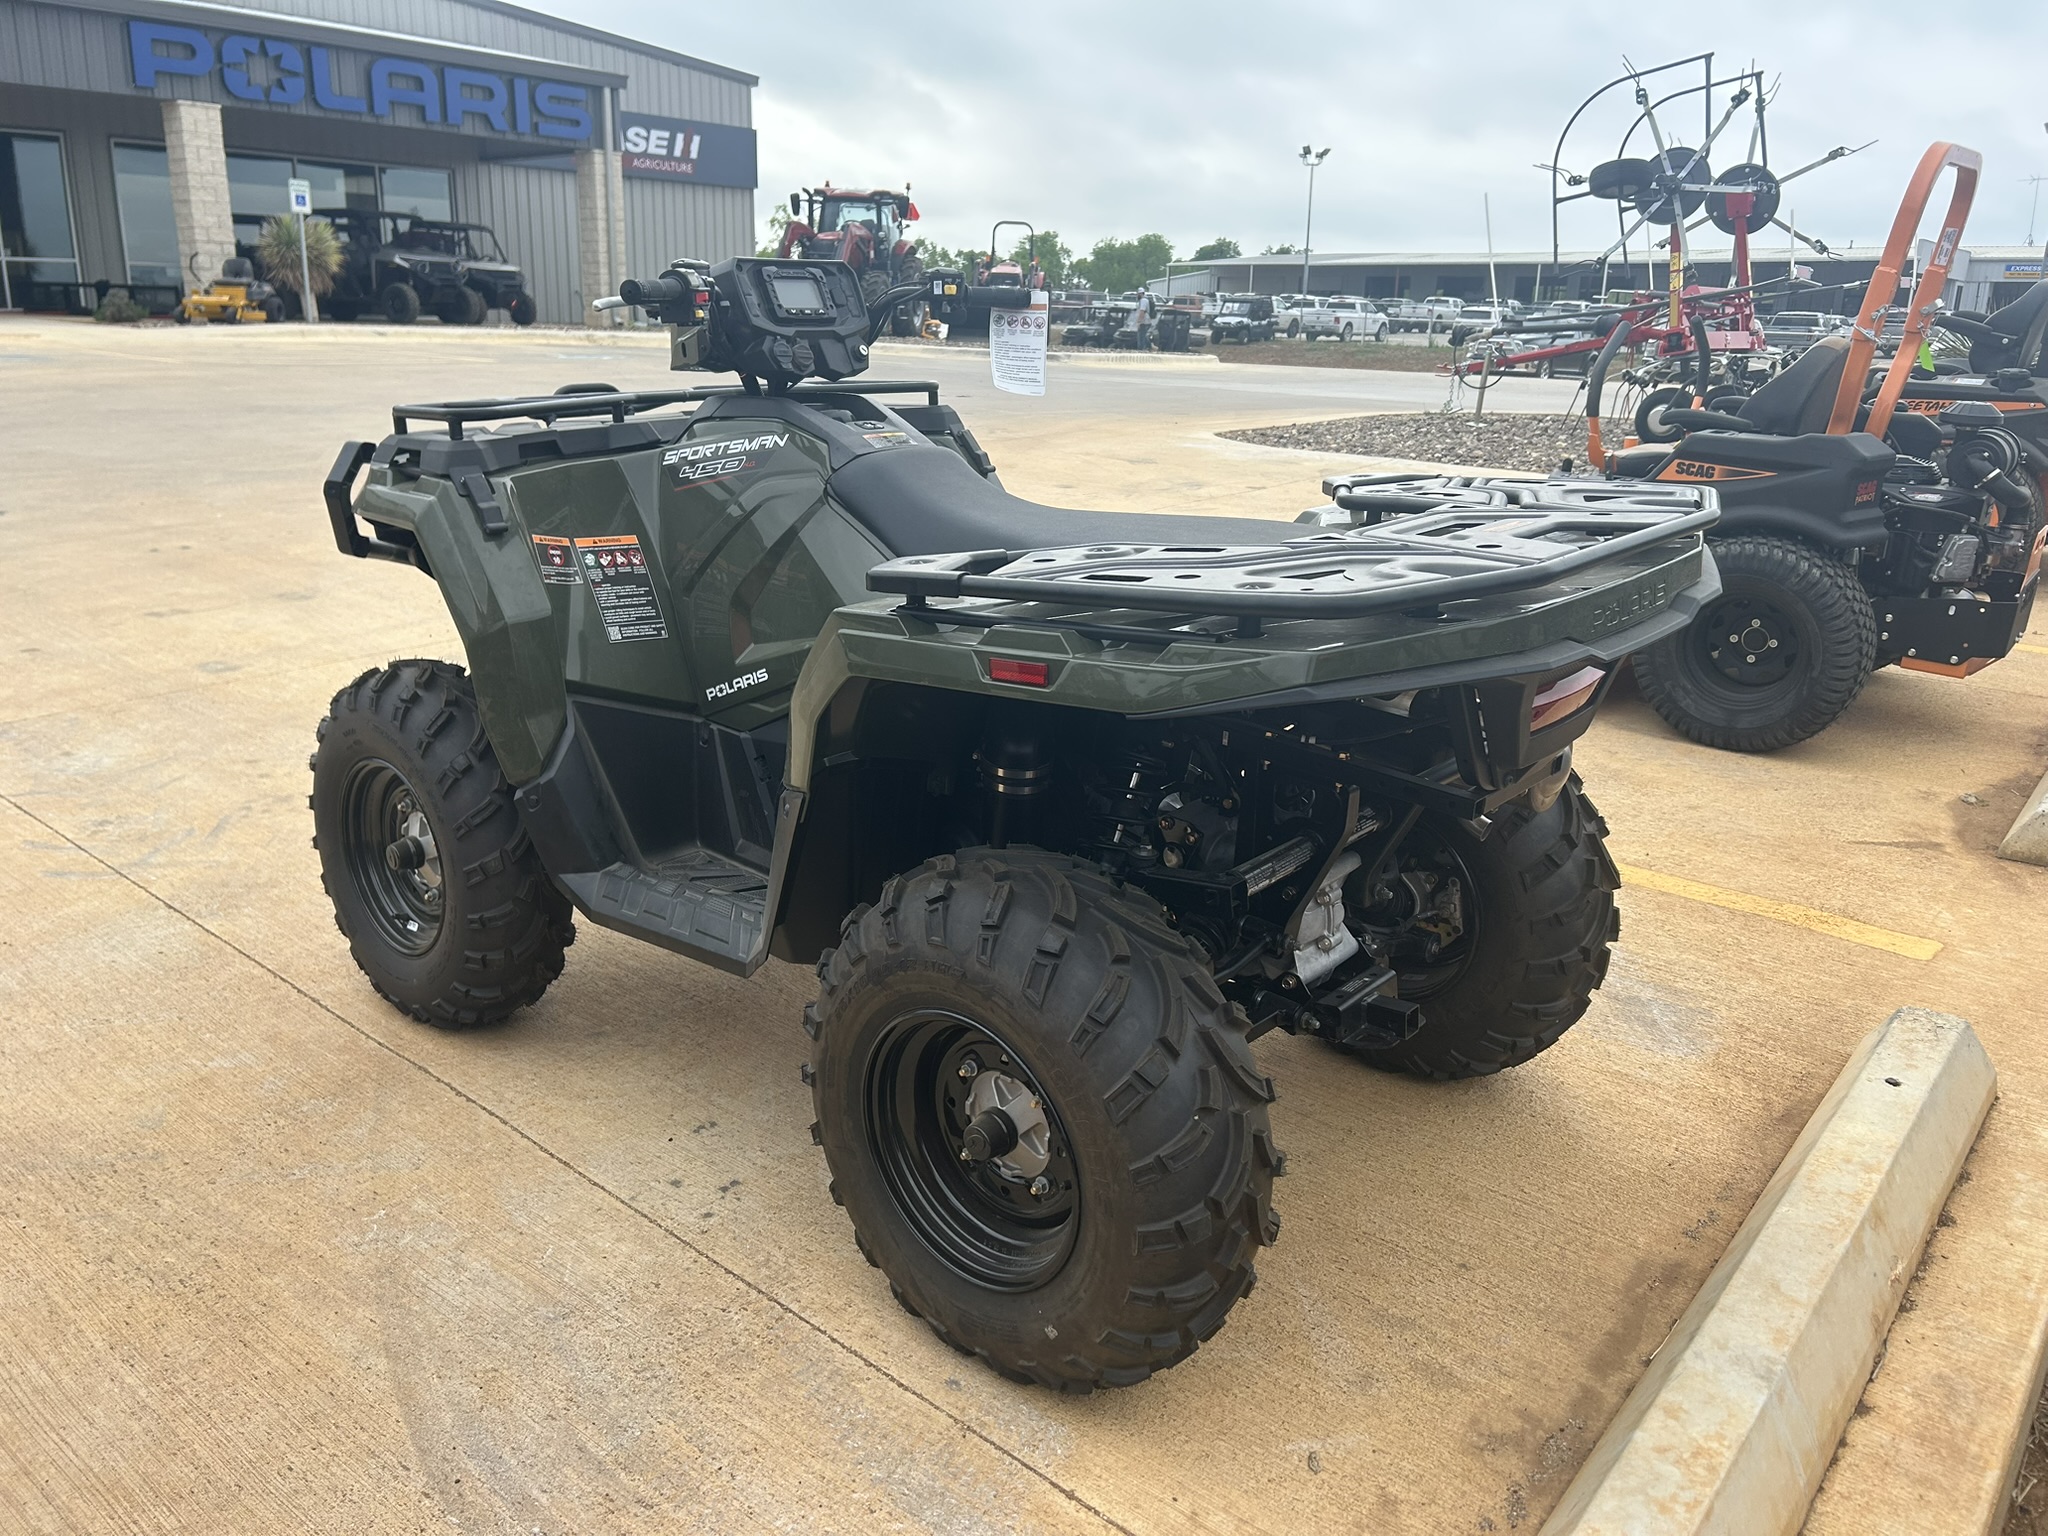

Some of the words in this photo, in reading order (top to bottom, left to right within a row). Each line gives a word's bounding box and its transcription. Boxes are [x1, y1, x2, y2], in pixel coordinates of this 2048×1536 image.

[128, 20, 593, 141] POLARIS
[620, 126, 670, 156] SE
[632, 157, 694, 174] AGRICULTURE
[662, 433, 790, 466] SPORTSMAN
[679, 456, 746, 480] 450
[1675, 462, 1716, 479] SCAG
[1591, 581, 1666, 632] POLARIS
[705, 668, 769, 701] POLARIS
